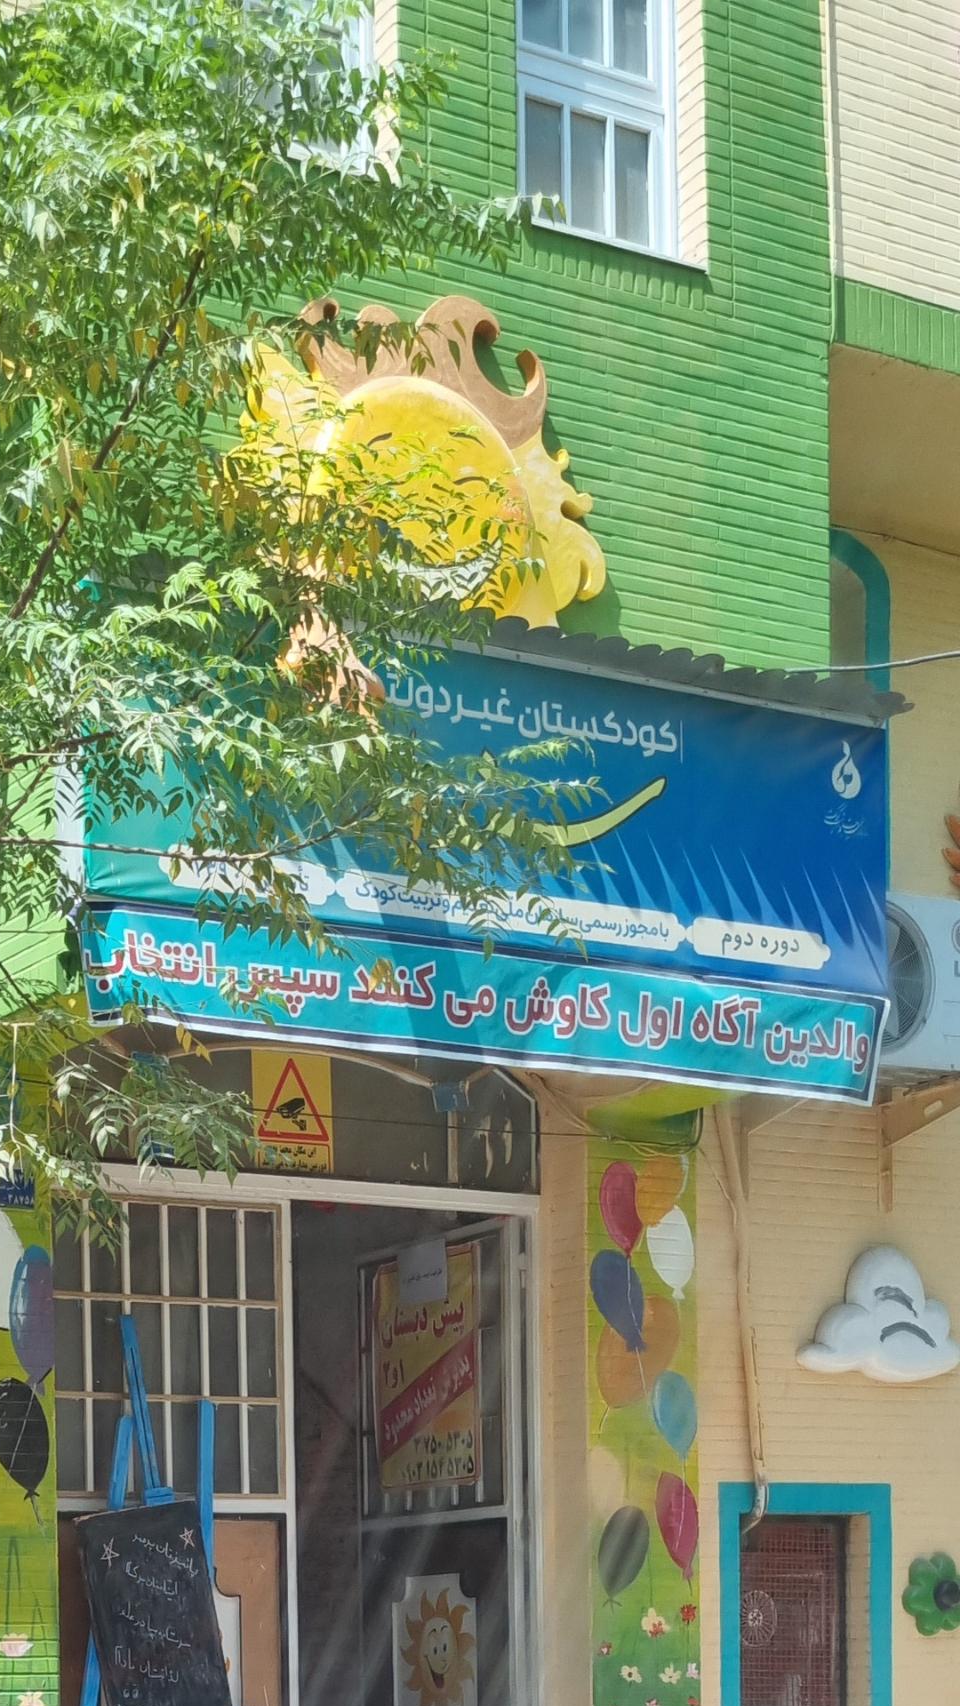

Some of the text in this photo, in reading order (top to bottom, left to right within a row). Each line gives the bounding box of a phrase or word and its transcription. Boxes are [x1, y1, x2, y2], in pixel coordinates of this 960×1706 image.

[518, 701, 678, 757] کودکستان
[355, 881, 398, 905] کودک
[579, 915, 622, 939] رسمی
[721, 931, 800, 957] دوره دوم
[84, 930, 217, 993] انتخاب
[443, 984, 496, 1029] می
[504, 977, 609, 1039] کاوش
[619, 991, 683, 1049] اول
[691, 995, 760, 1049] آگاه
[764, 1017, 869, 1075] والدین
[381, 1299, 465, 1350] پیش دبستان
